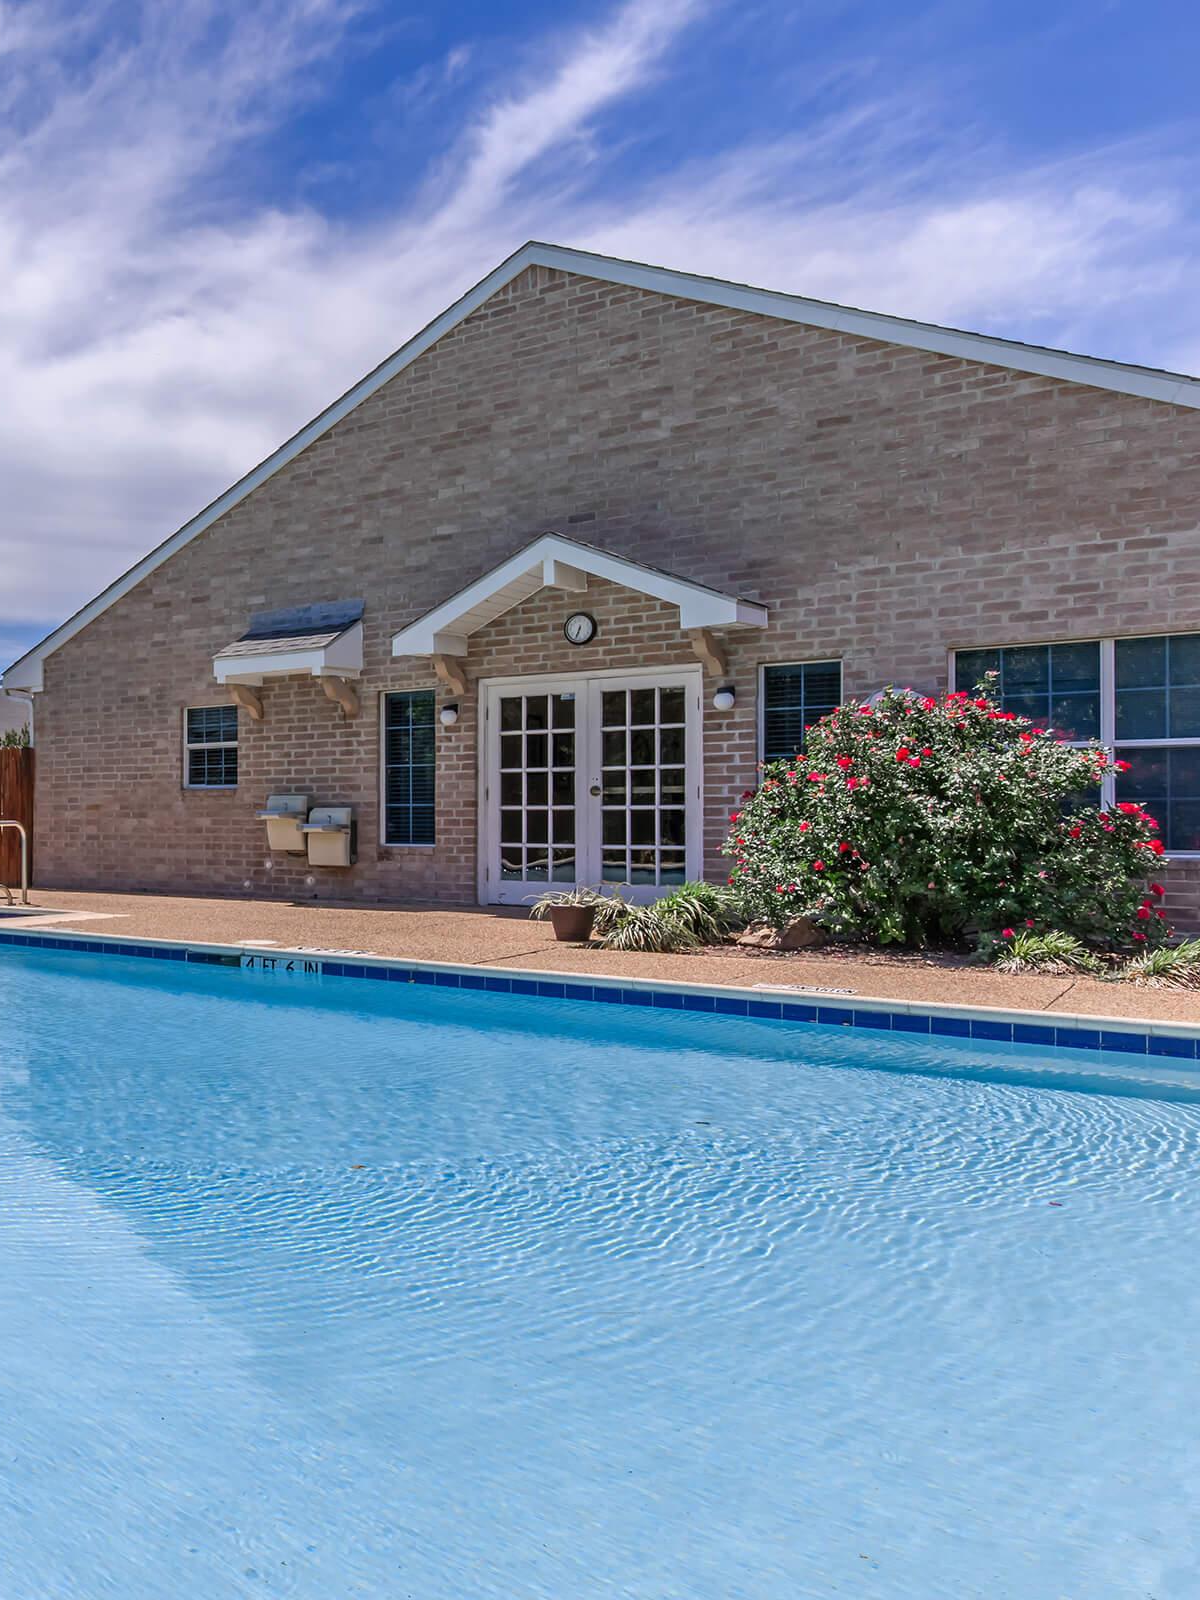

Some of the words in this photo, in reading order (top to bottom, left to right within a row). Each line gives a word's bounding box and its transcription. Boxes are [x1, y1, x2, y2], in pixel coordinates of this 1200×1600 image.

[262, 958, 278, 969] FT
[286, 961, 295, 971] 6
[304, 960, 319, 973] IN
